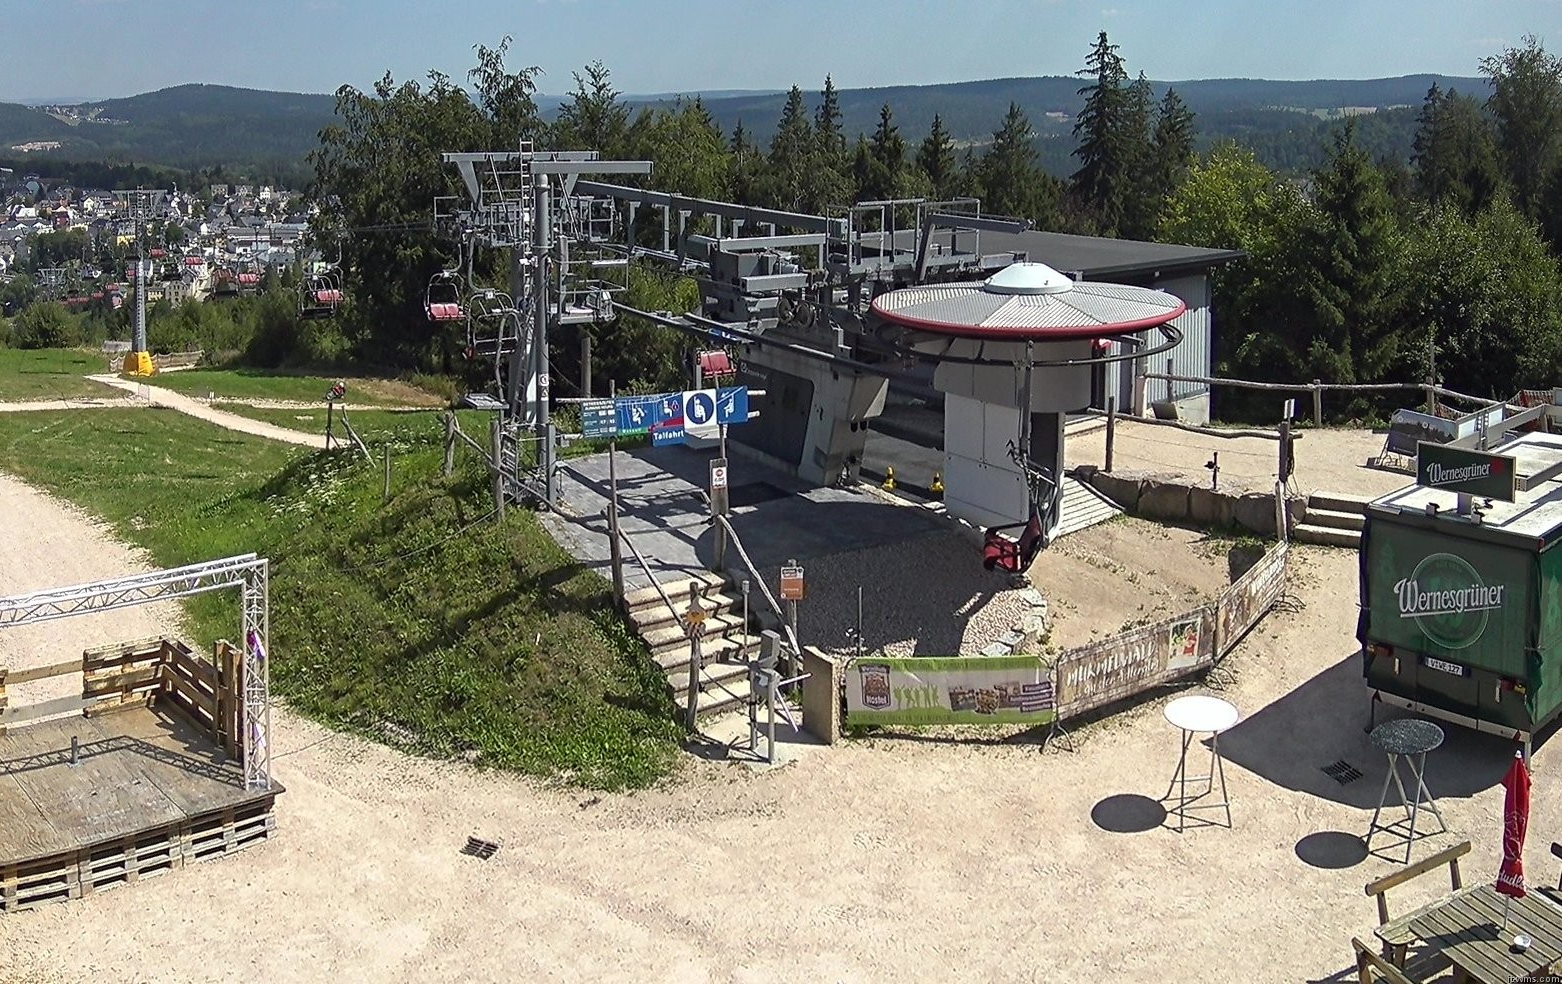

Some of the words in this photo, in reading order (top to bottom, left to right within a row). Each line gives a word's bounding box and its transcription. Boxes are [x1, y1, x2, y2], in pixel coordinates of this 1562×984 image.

[653, 430, 684, 440] Talfahrt
[1426, 462, 1490, 482] Wernesgrüner
[1393, 577, 1504, 613] Wernesgrüner
